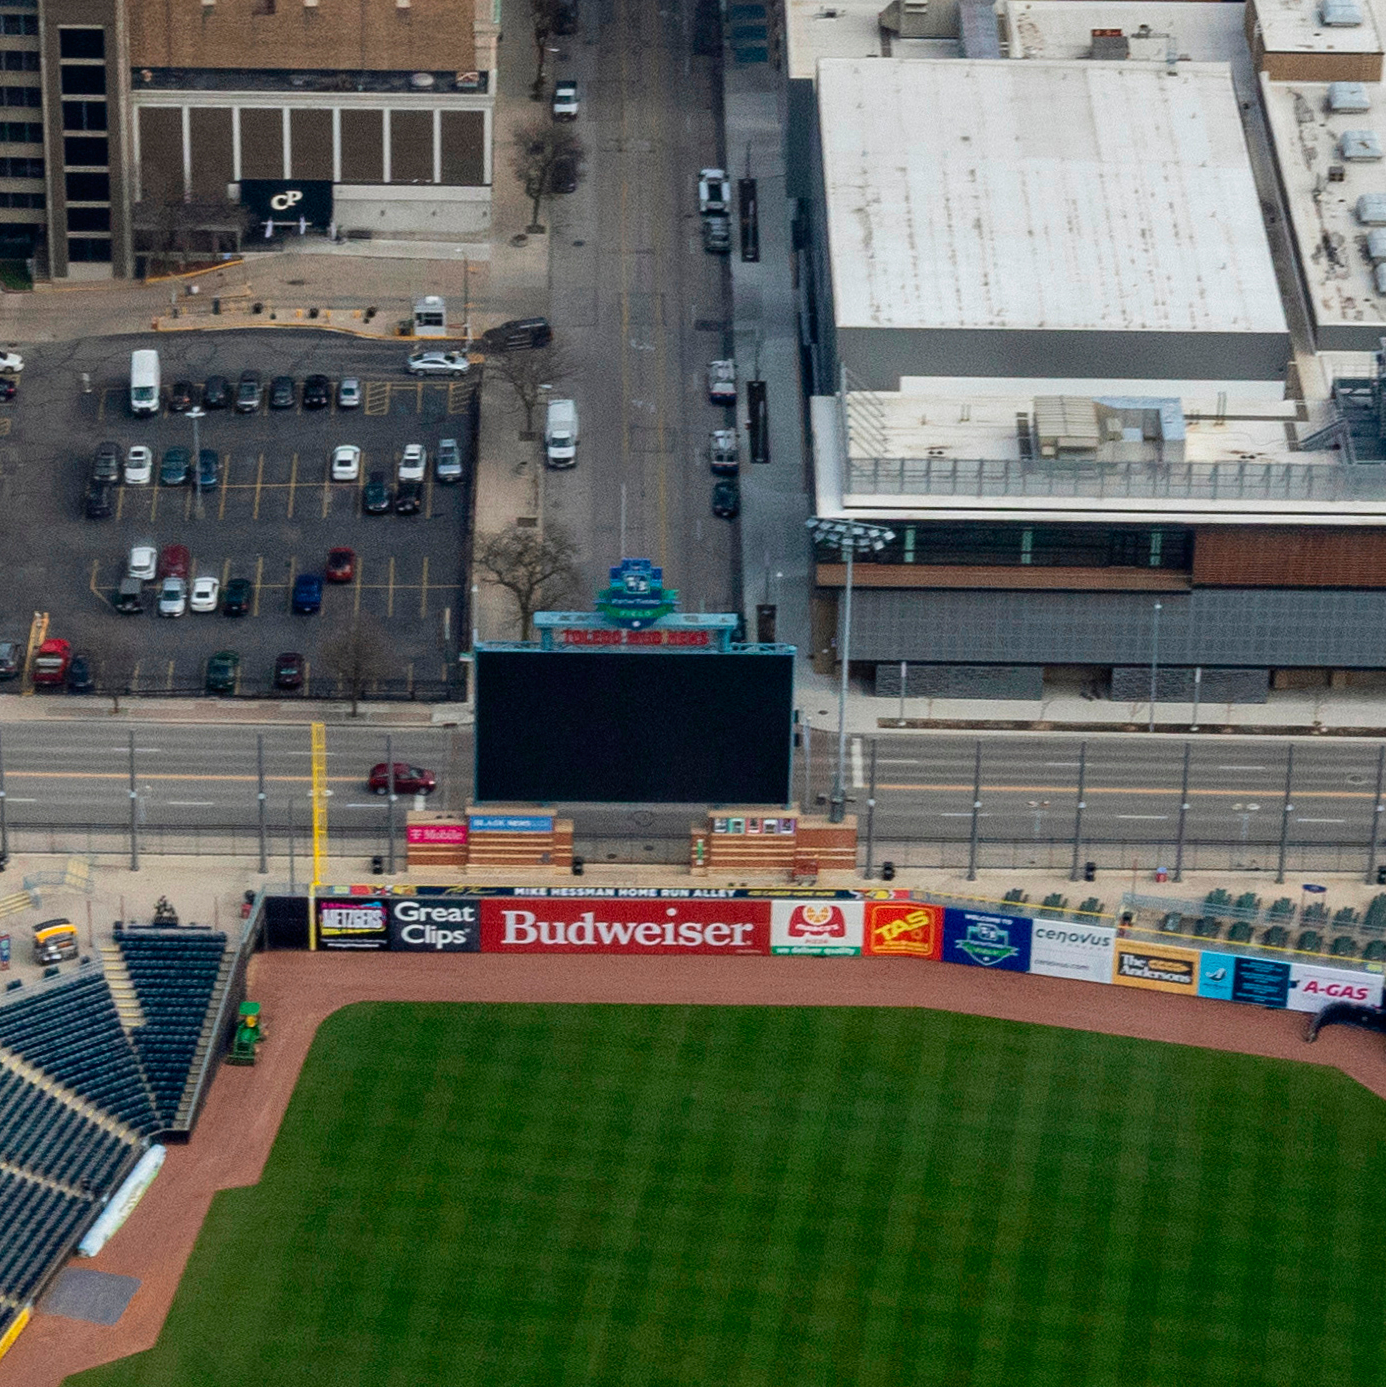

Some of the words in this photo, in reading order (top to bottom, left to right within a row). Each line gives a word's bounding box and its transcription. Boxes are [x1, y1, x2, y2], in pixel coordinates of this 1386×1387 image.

[271, 191, 303, 210] CP
[514, 888, 548, 896] MIKE
[551, 888, 615, 896] HESSMAN
[618, 888, 658, 897] HOME
[661, 889, 689, 897] RUN
[693, 889, 736, 898] ALLEY
[394, 901, 476, 922] Great
[501, 907, 754, 946] Budweiser
[874, 910, 929, 940] TAS
[401, 925, 468, 950] Clips
[1036, 927, 1111, 948] cenovus
[1122, 952, 1147, 970] The
[1121, 962, 1192, 983] Andersons
[1303, 981, 1369, 1000] A-GAS
